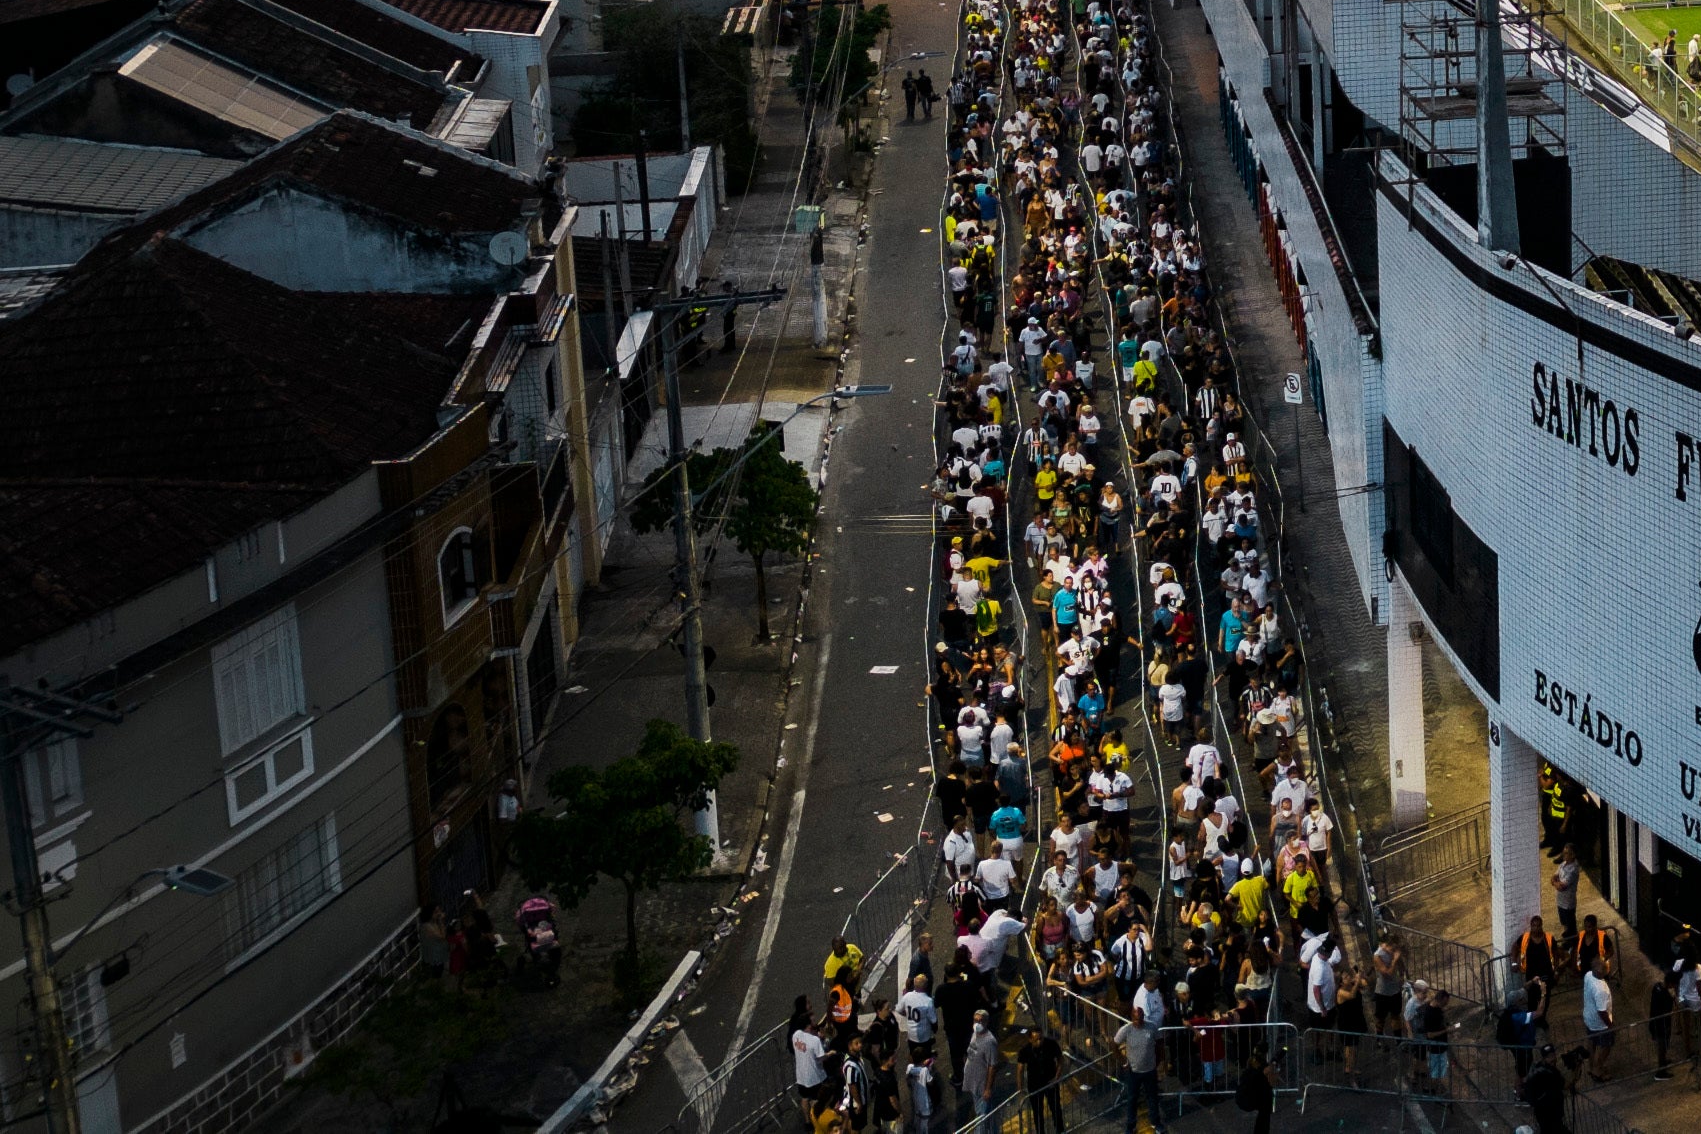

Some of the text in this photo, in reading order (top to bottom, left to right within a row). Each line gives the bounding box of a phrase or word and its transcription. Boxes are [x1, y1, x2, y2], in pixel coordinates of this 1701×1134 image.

[1531, 362, 1640, 476] SANTOS
[1161, 483, 1172, 494] 10
[1534, 668, 1643, 767] ESTÁDIO
[907, 1005, 921, 1023] 10
